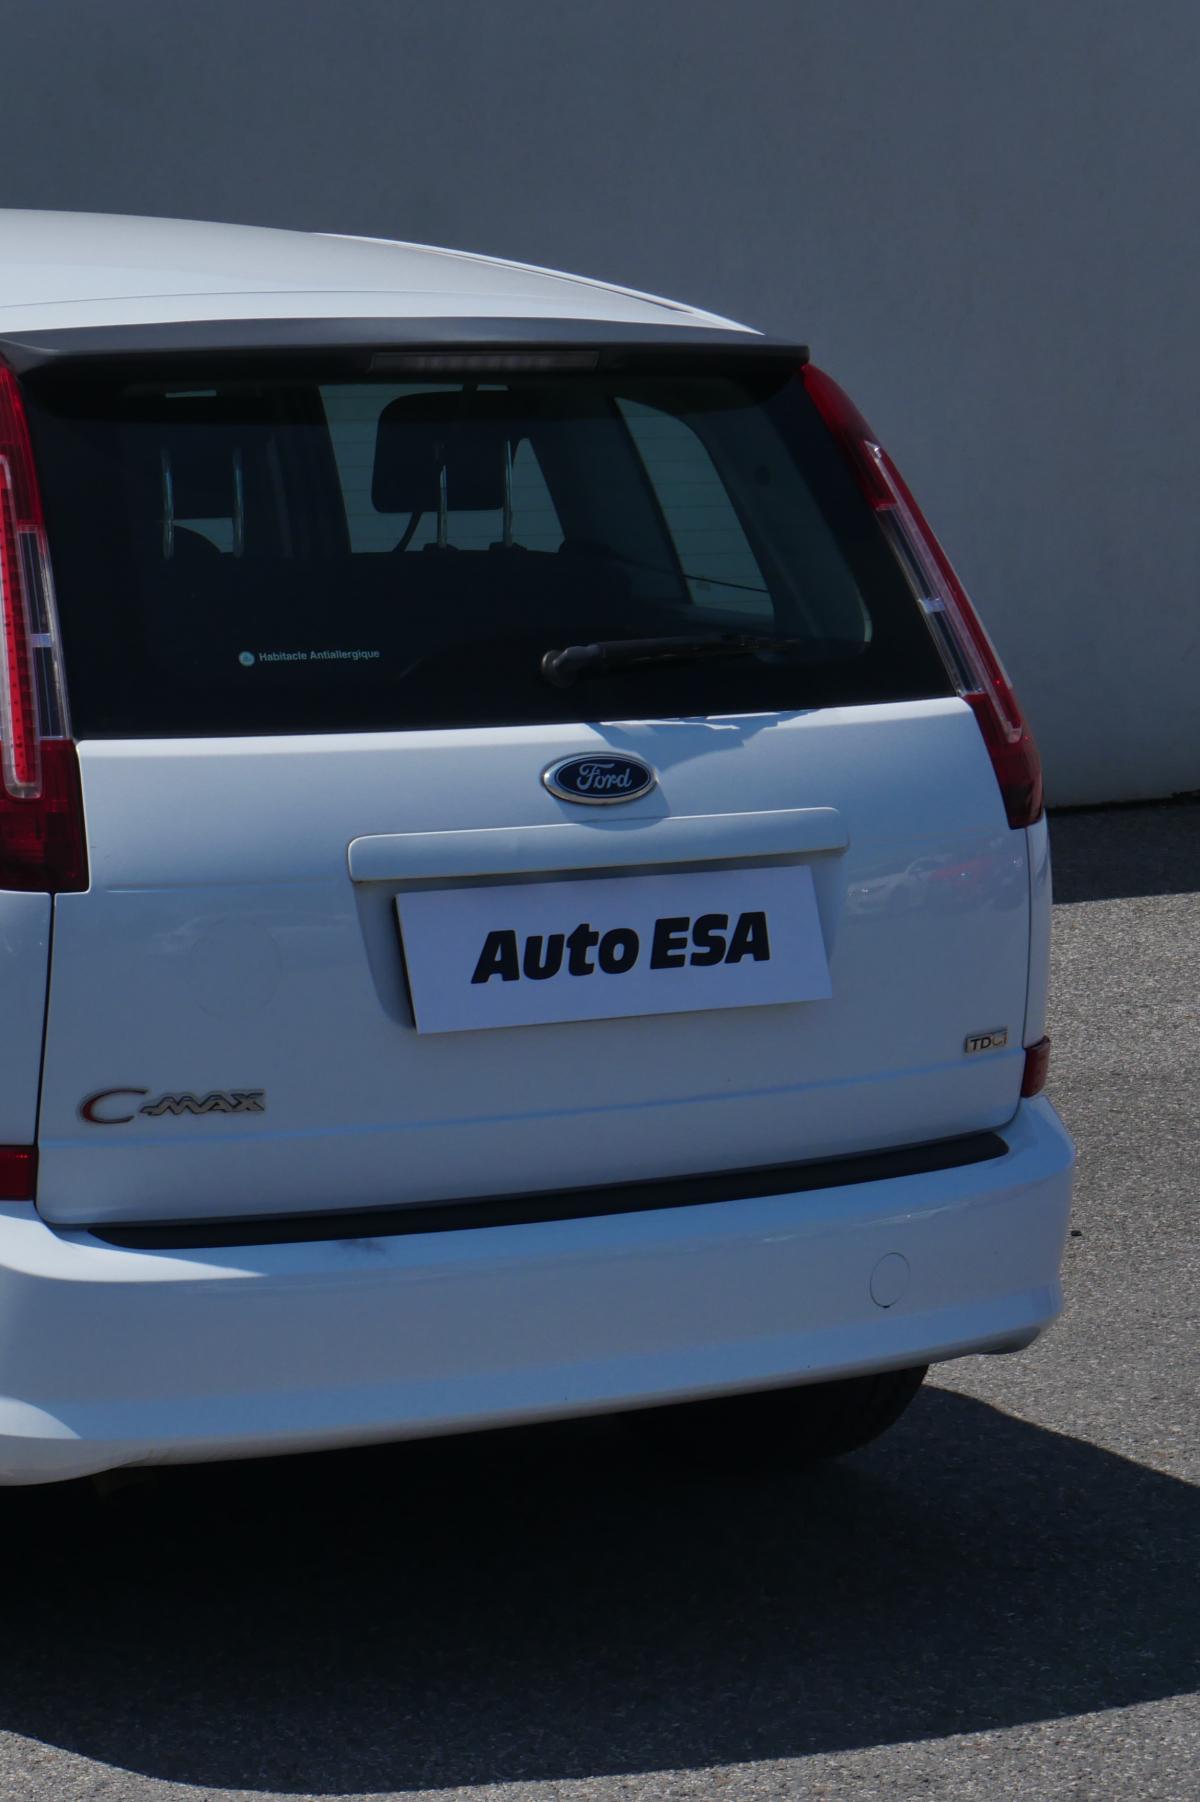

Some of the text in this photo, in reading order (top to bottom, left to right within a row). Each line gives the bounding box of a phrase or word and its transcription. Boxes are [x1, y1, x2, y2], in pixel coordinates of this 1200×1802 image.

[258, 649, 380, 662] Habitacle Antiallergique
[576, 762, 632, 790] Ford
[471, 911, 770, 984] Auto ESA
